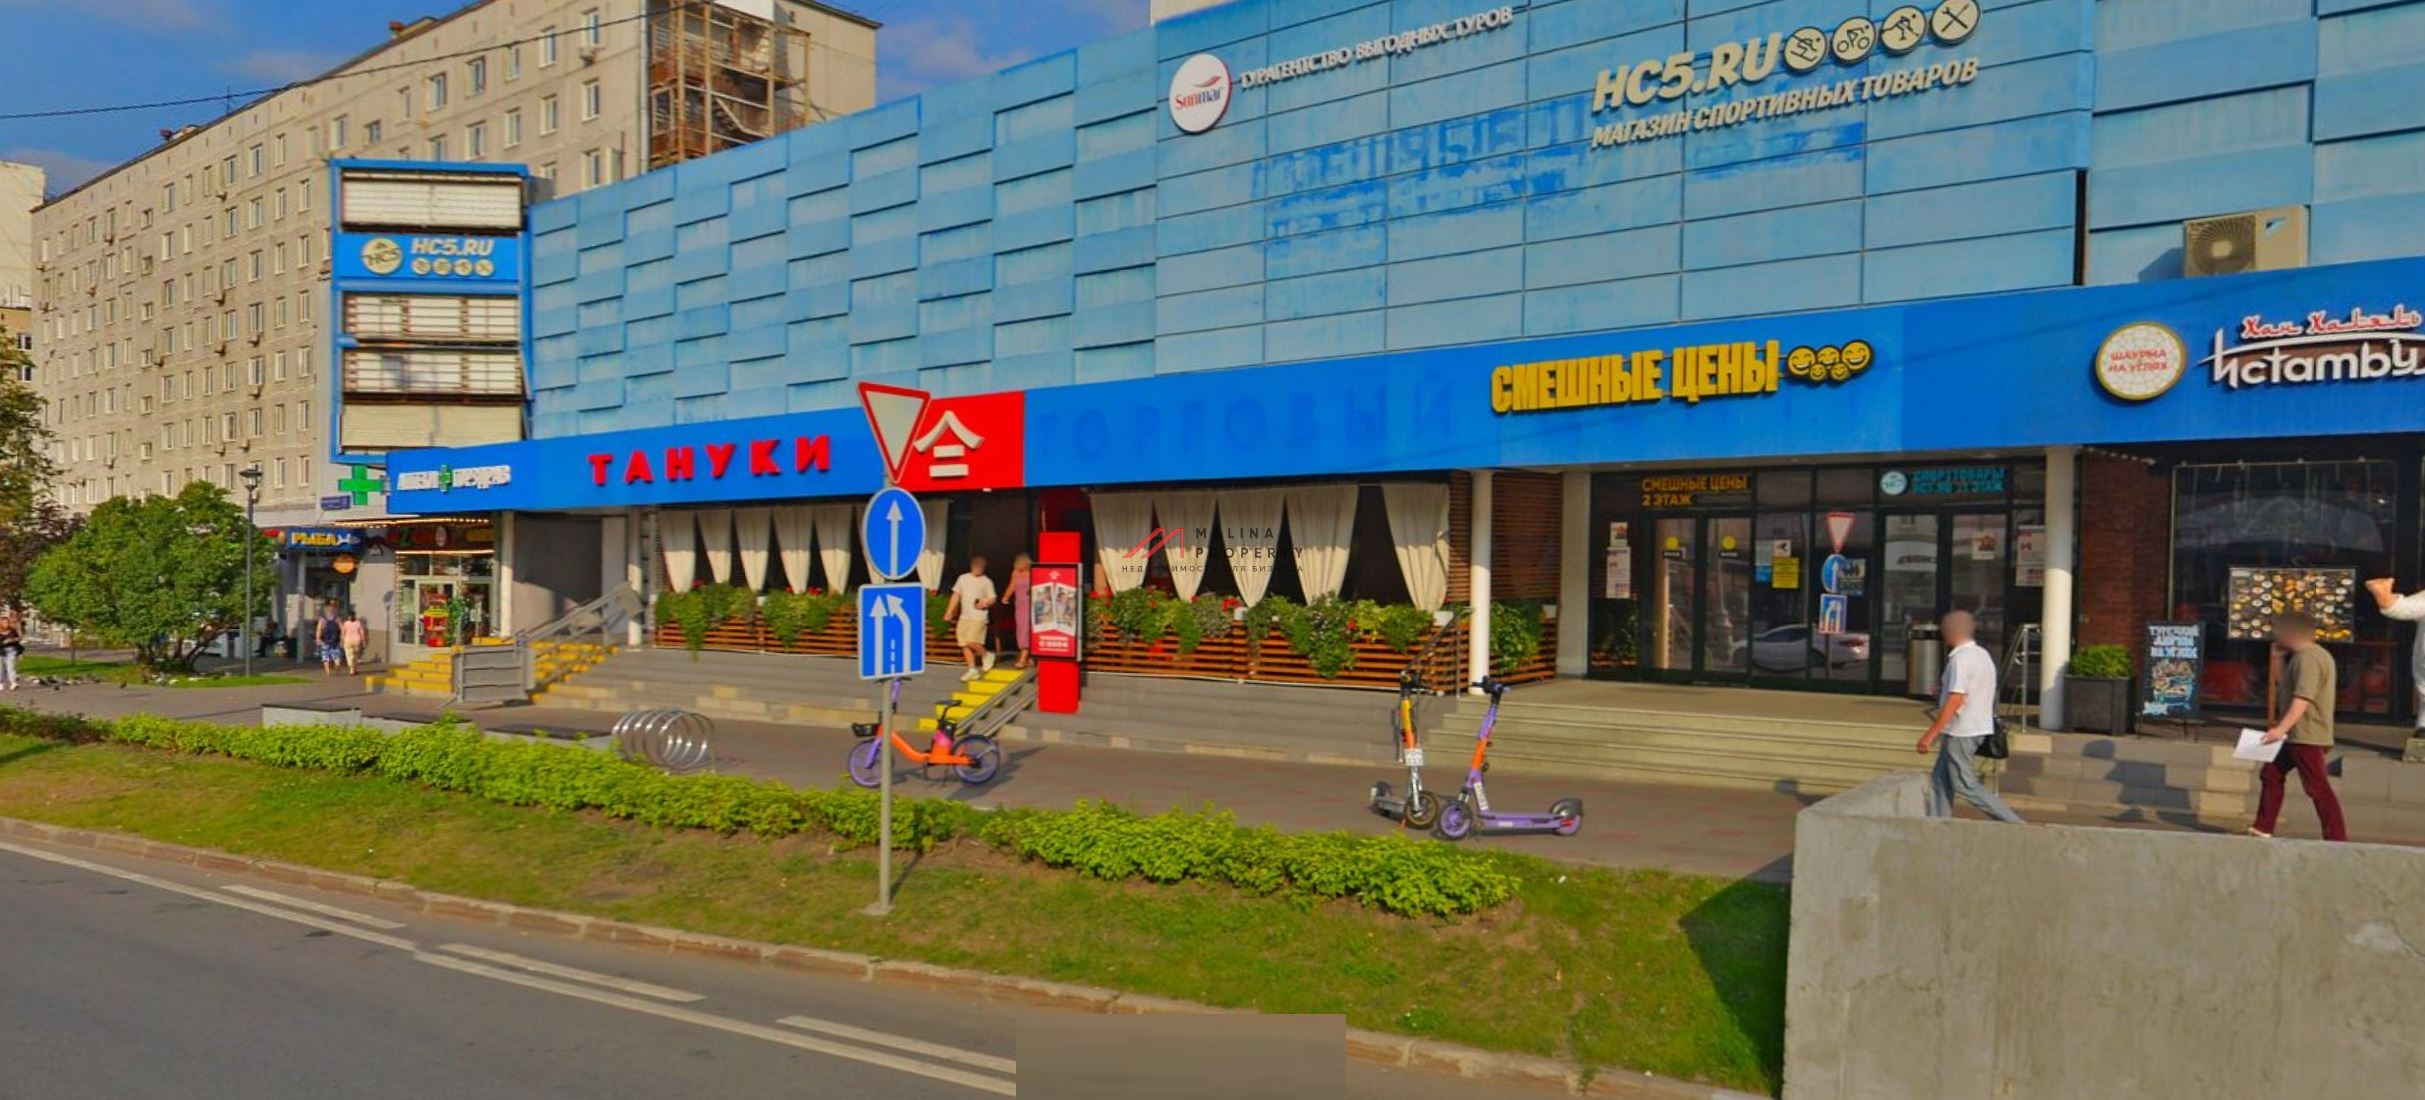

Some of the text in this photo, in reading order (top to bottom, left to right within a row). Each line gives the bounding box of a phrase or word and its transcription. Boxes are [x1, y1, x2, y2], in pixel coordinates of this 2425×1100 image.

[1241, 6, 1513, 87] ТУРАГЕНТСТВО ВЫГОДНЫХ ТУРОВ
[1591, 108, 1689, 149] МАГАЗИН
[1694, 77, 1856, 129] СПОРТИВНЫХ
[1859, 57, 1980, 101] ТОВАРОВ
[2108, 361, 2168, 372] НА УГЛЯХ
[2110, 349, 2167, 361] ШАУРМА
[1491, 340, 1780, 413] СМЕШНЫЕ ЦЕНЫ
[586, 435, 831, 486] ТАНУКИ
[1641, 475, 1748, 492] СМЕШНЫЕ ЦЕНЫ
[1641, 494, 1693, 507] 2 ЭТАЖ
